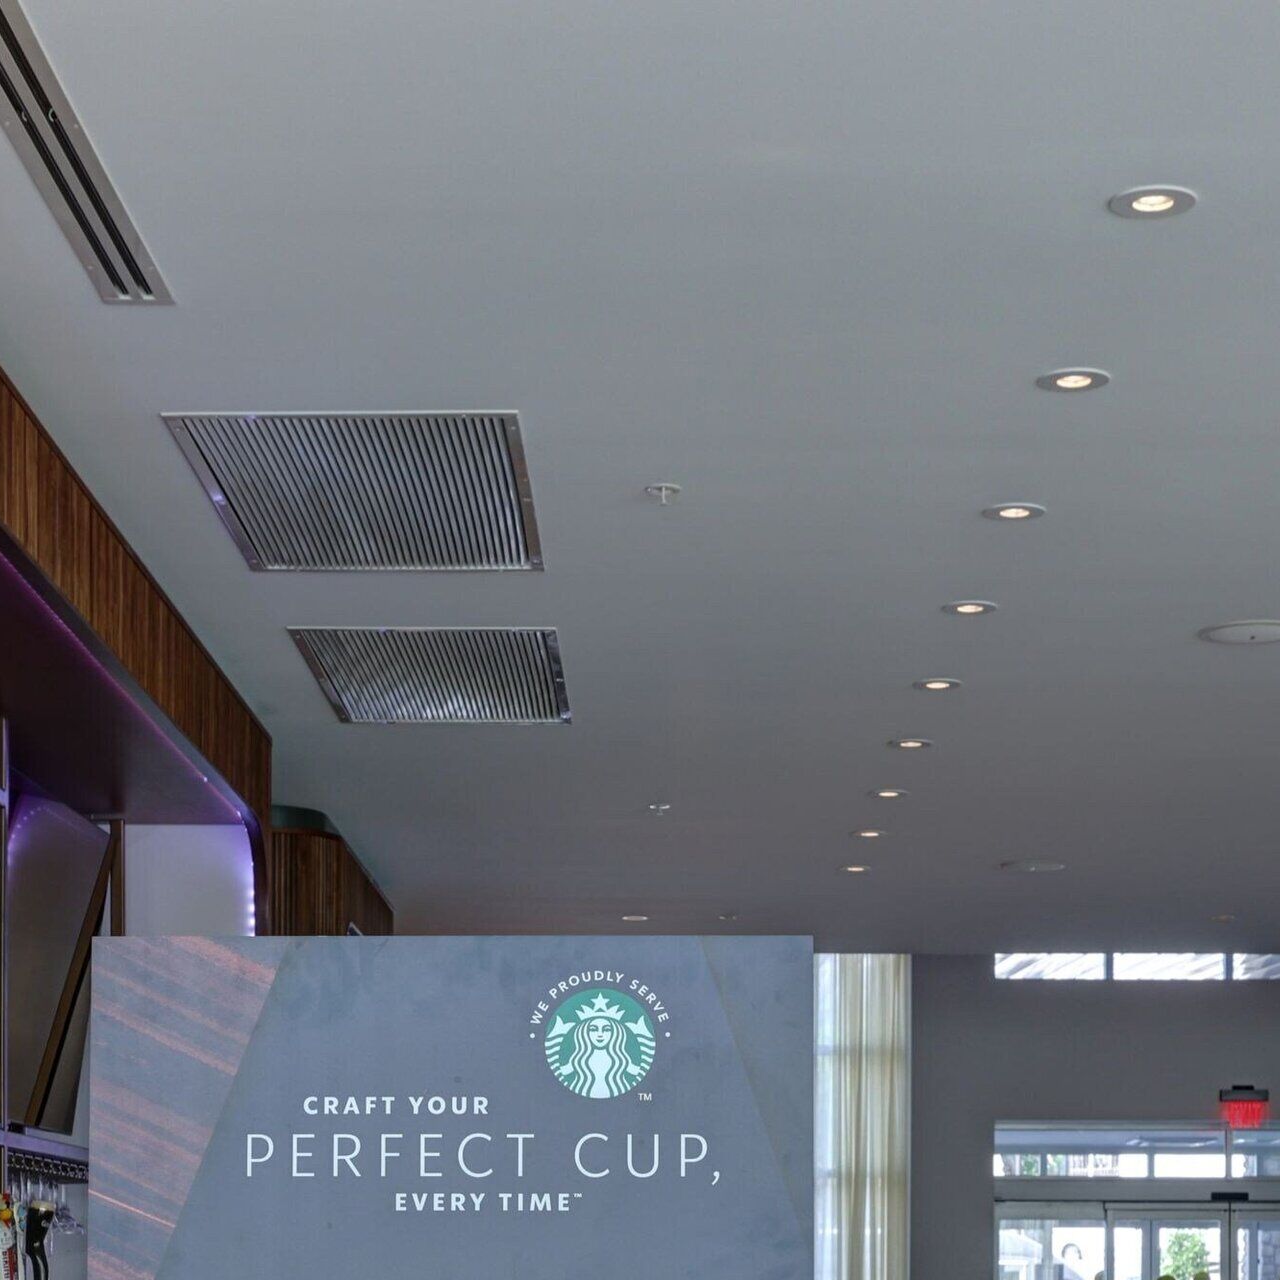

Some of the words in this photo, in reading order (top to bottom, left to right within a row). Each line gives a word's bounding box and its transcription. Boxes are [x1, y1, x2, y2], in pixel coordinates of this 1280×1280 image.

[530, 1000, 549, 1025] WE
[549, 970, 624, 999] PROUDLY
[629, 979, 669, 1023] SERVE
[303, 1096, 395, 1115] CRAFT
[409, 1096, 489, 1115] YOUR
[246, 1132, 534, 1178] PERFECT
[574, 1132, 720, 1186] CUP,
[395, 1193, 486, 1212] EVERY
